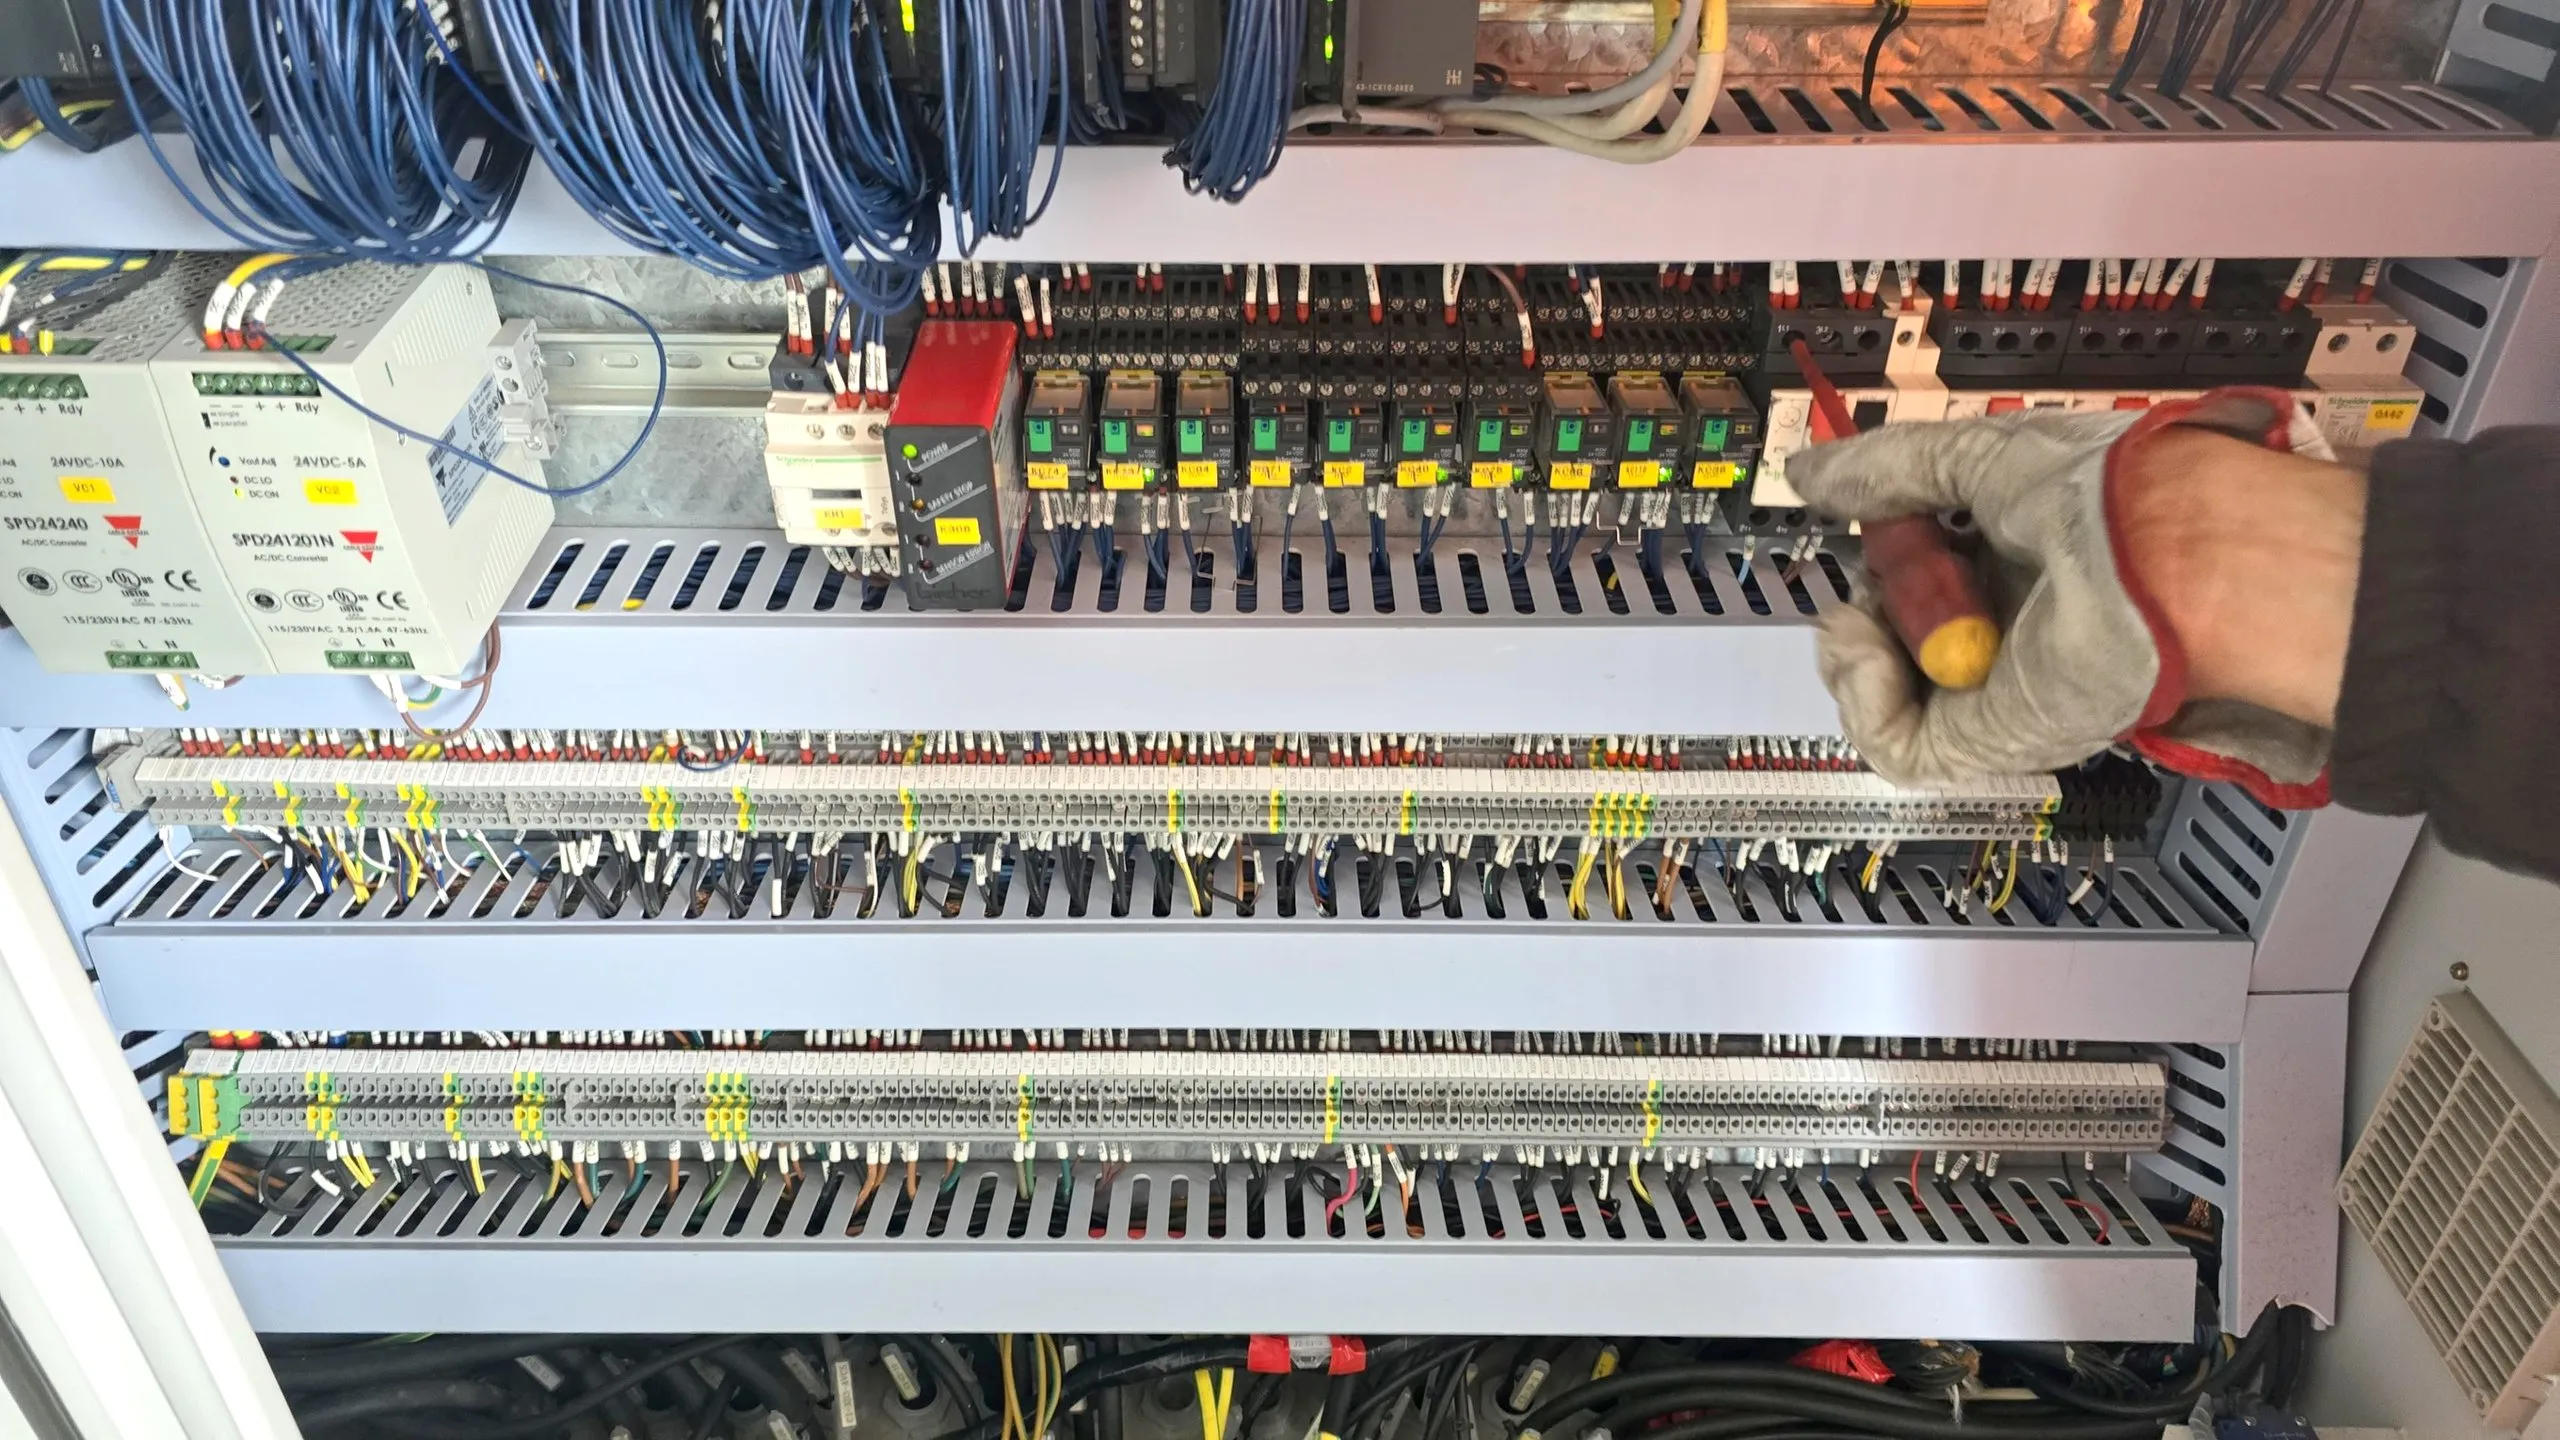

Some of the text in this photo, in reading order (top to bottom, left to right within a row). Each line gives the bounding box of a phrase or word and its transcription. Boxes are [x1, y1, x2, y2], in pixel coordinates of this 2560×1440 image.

[92, 43, 102, 58] 2
[295, 403, 319, 414] Rdy
[2327, 397, 2371, 409] Schneider
[58, 403, 83, 416] Rdy
[50, 457, 125, 468] 24VDC-10A
[293, 456, 367, 468] 24VDC-5A
[775, 455, 813, 467] Schneider
[244, 476, 259, 484] DC
[249, 490, 264, 498] DC
[265, 490, 280, 498] ON
[954, 481, 973, 498] STOP
[4, 516, 89, 531] SPD24240
[21, 539, 48, 547] AC/DC
[232, 533, 335, 548] SPD241201N
[63, 615, 193, 625] 115/230VAC 47-63Hz
[138, 640, 178, 649] L N
[356, 638, 396, 647] L N
